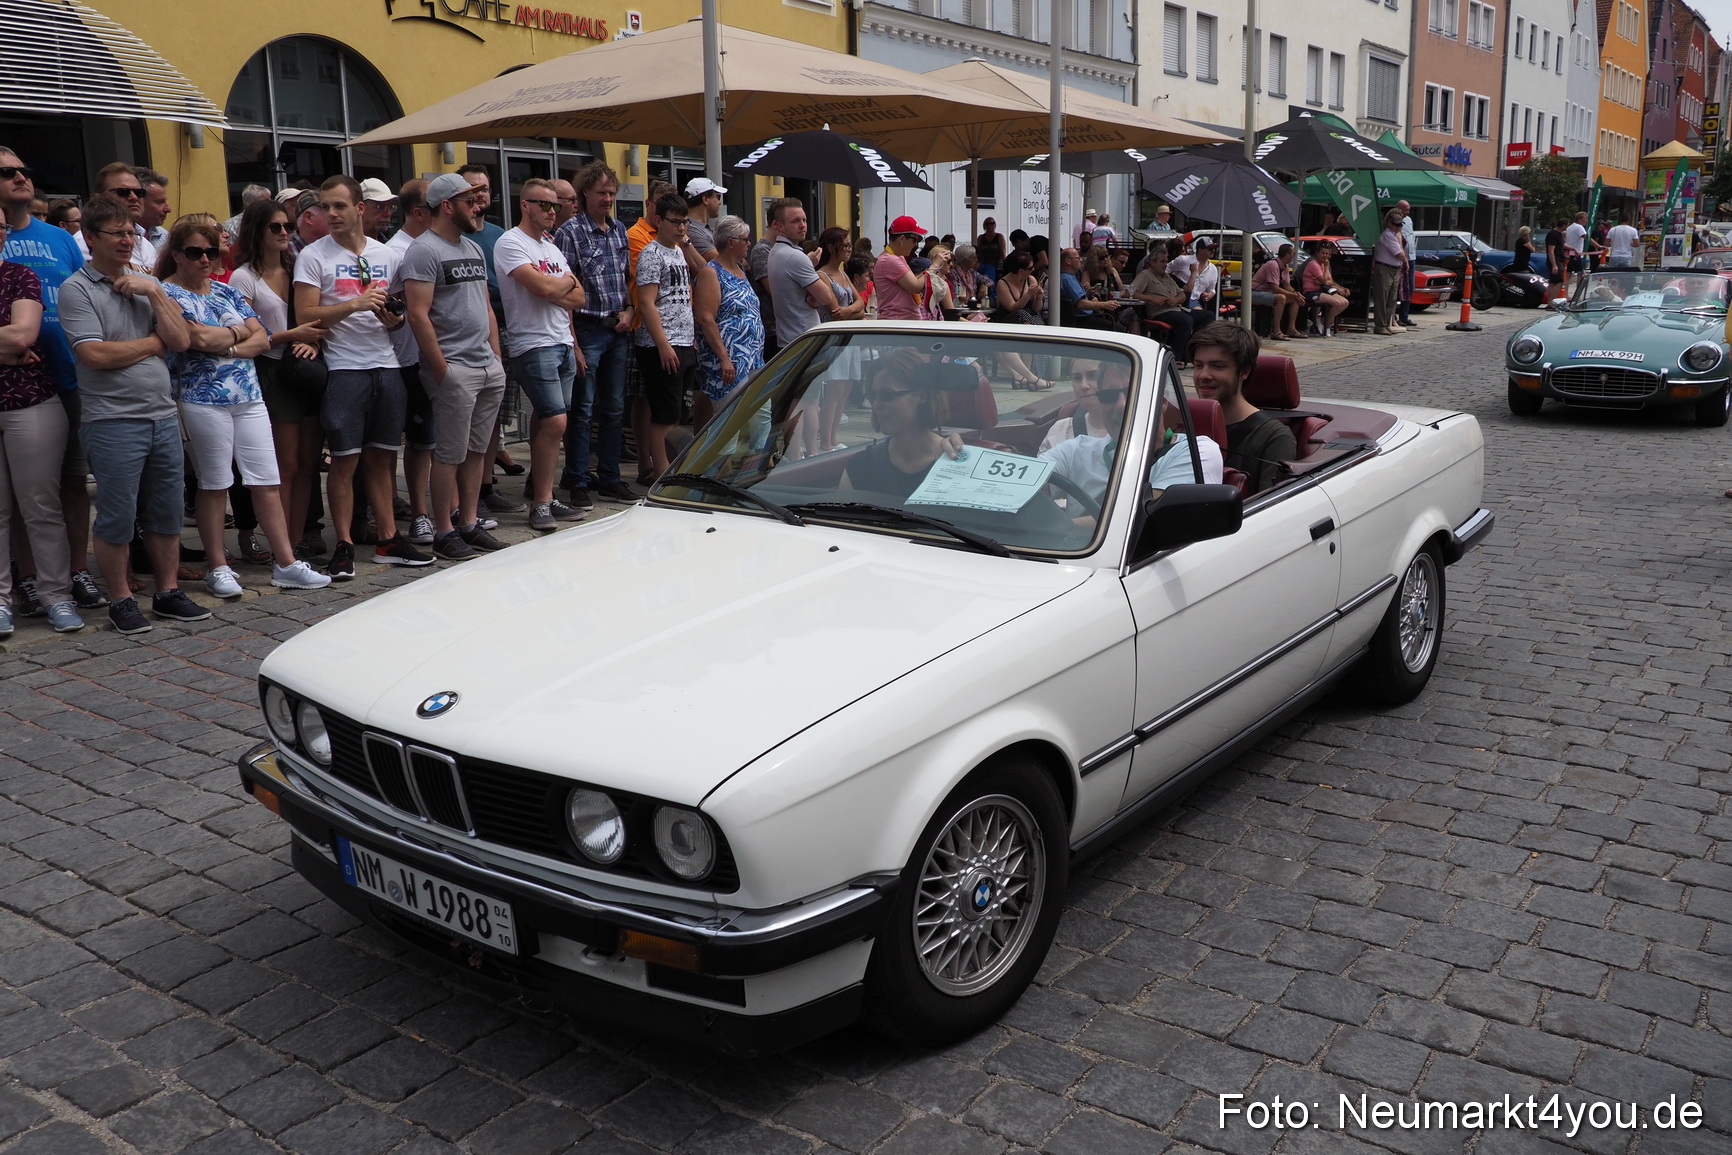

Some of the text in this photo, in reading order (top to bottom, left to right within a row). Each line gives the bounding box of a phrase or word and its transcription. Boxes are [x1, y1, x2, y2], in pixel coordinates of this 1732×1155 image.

[516, 5, 542, 28] AM
[545, 9, 608, 40] RATHAUS
[1701, 103, 1719, 175] HOTEL
[1032, 181, 1043, 195] 30
[1023, 198, 1039, 212] Bang
[1041, 199, 1045, 210] &
[1028, 214, 1034, 224] in
[335, 264, 388, 278] PESI
[1600, 350, 1616, 358] XK
[1618, 351, 1643, 361] 99H
[987, 459, 1029, 480] 531
[352, 846, 492, 940] NM W 1988
[493, 904, 508, 920] 04
[498, 933, 512, 948] 10
